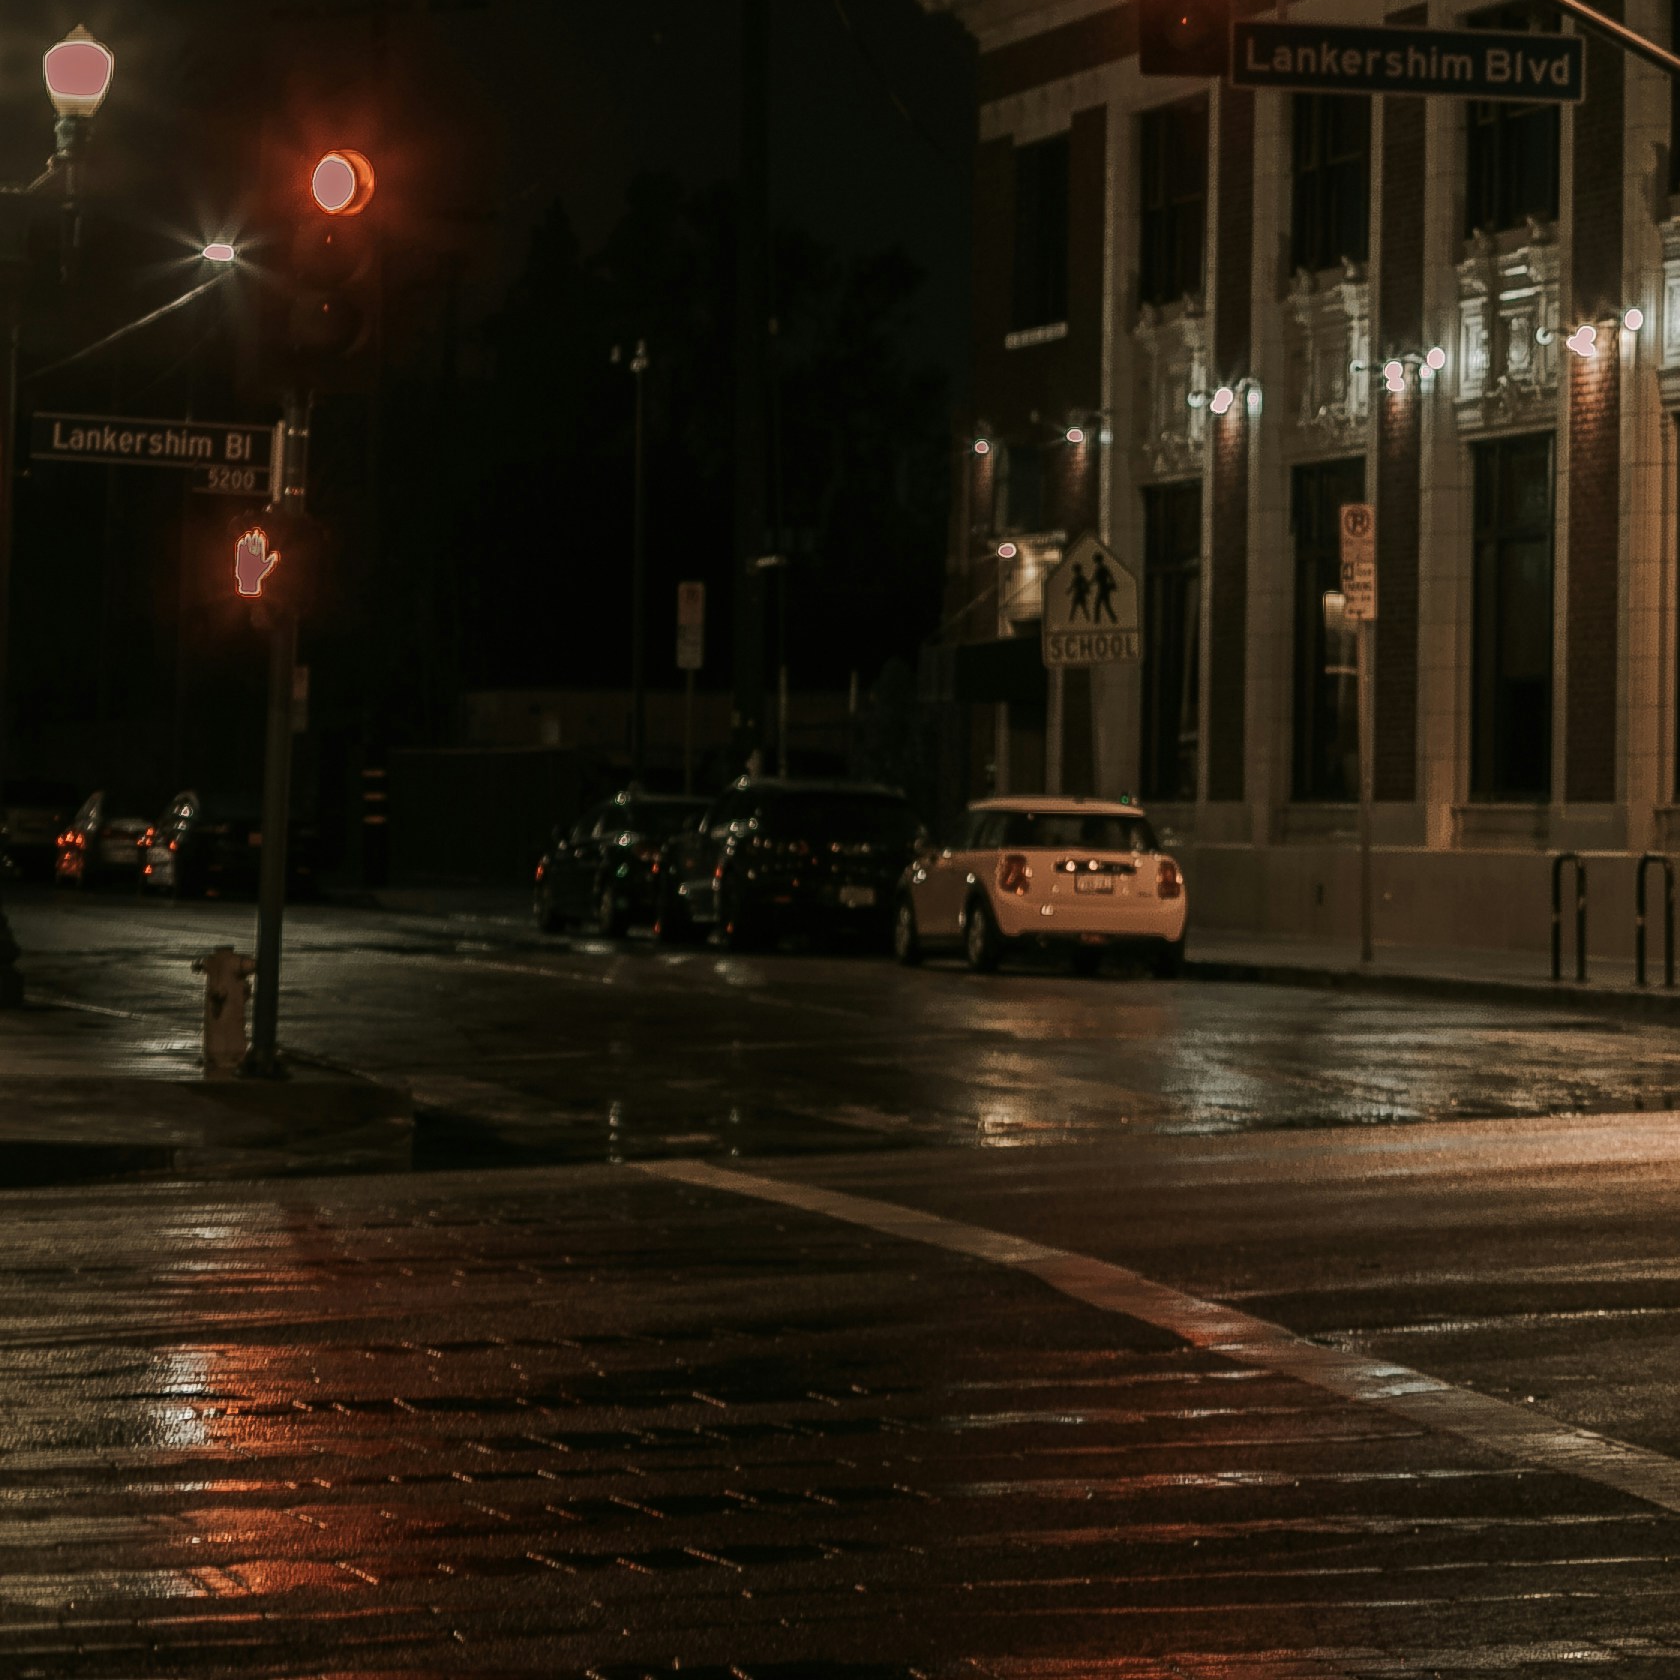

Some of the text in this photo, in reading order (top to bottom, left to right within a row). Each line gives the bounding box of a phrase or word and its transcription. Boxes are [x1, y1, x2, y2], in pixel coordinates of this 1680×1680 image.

[1245, 35, 1572, 87] Lankershim Blvd
[52, 420, 251, 462] Lankershim Bl
[207, 467, 256, 490] 5200
[1049, 633, 1137, 660] SCHOOL
